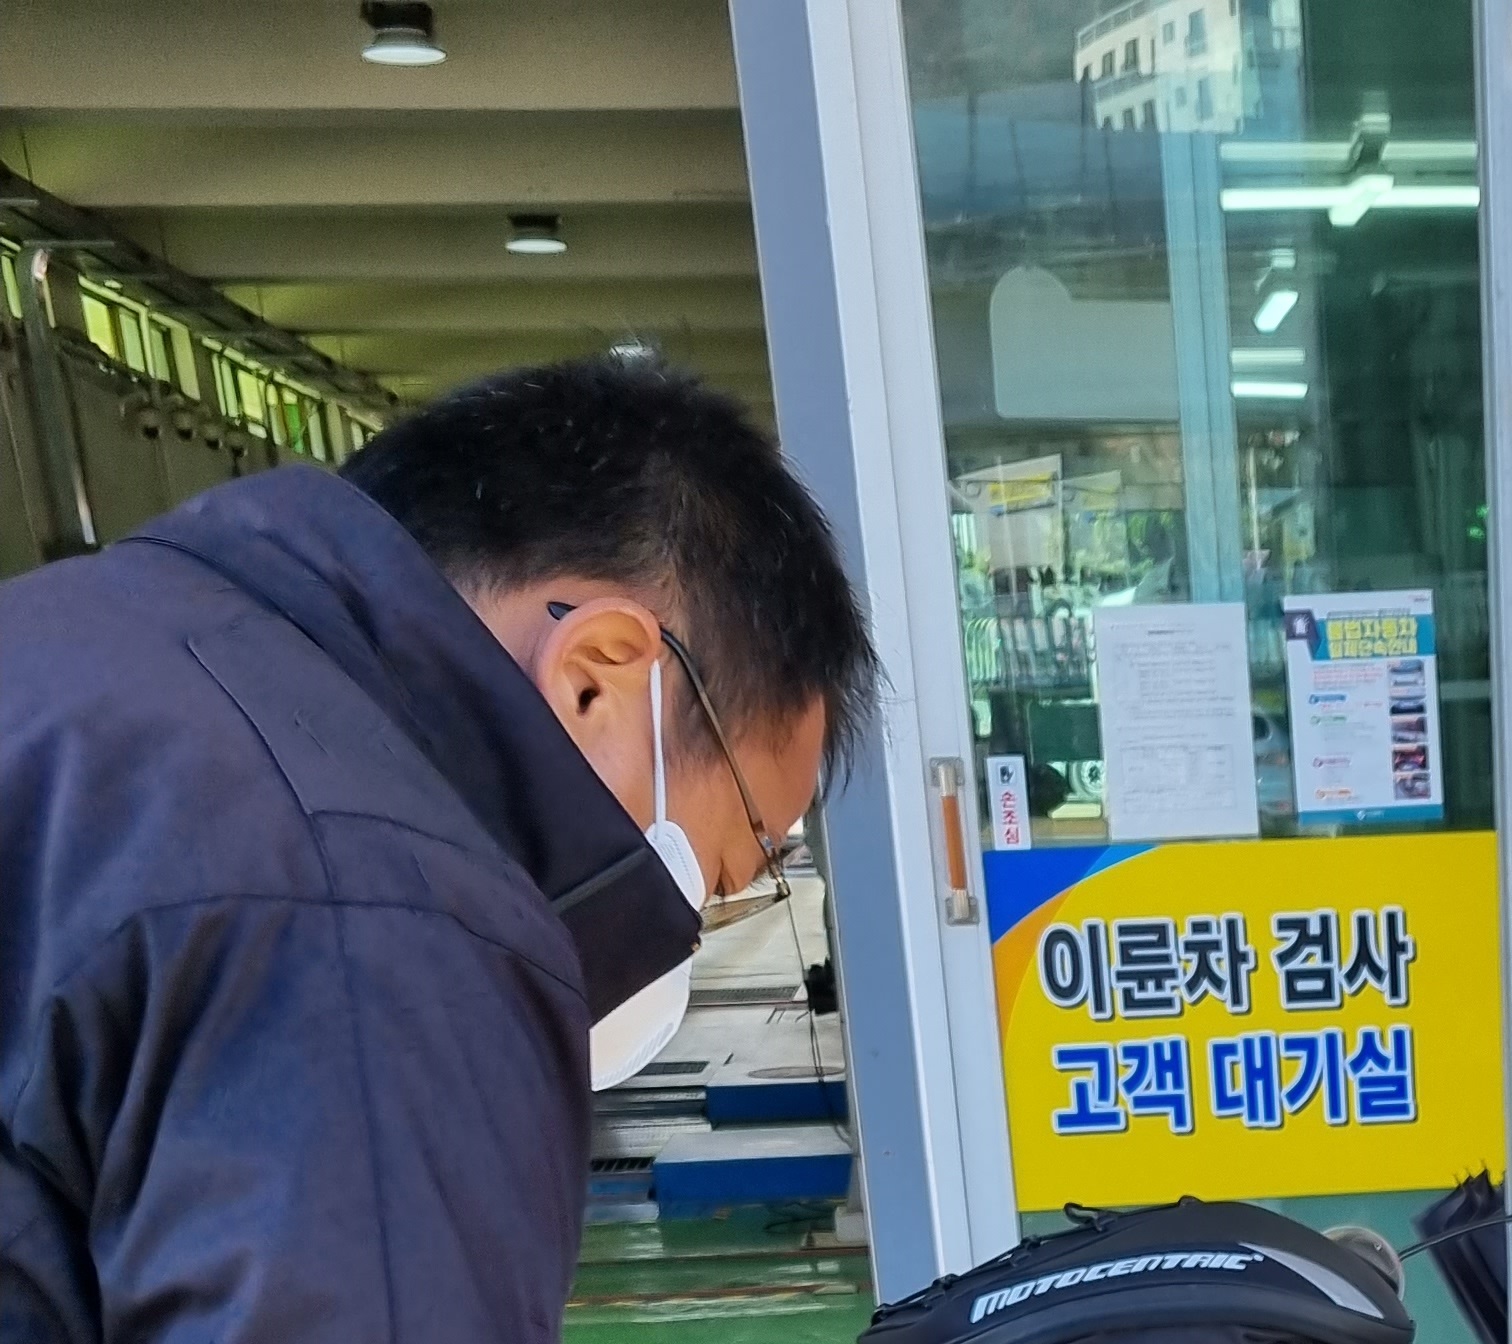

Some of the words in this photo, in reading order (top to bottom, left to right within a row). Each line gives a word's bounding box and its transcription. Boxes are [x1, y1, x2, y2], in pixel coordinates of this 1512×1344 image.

[1040, 915, 1254, 1018] 이륜차
[1273, 907, 1415, 1007] 검사
[1053, 1036, 1191, 1133] 고객
[1209, 1025, 1415, 1127] 대기실
[969, 1251, 1258, 1324] MOTOCENTRIC
